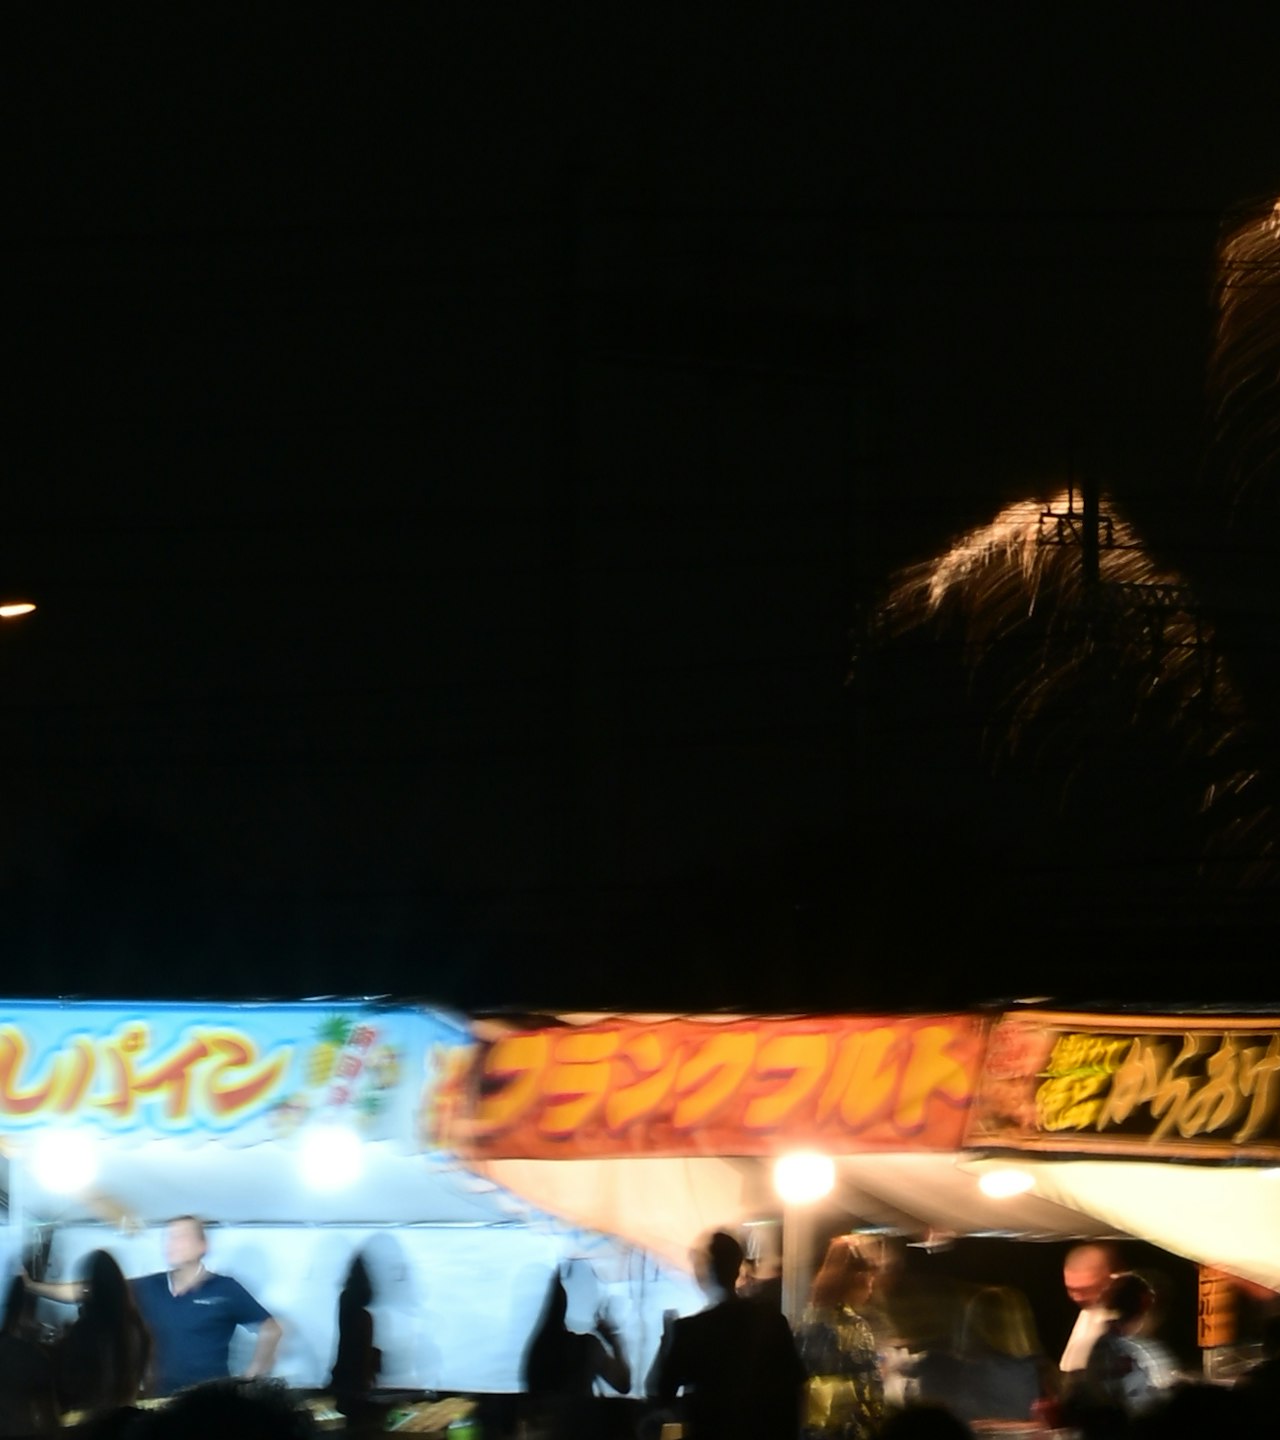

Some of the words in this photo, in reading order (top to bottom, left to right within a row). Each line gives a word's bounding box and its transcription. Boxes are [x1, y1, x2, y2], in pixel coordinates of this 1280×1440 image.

[476, 1026, 972, 1138] フランクフルト
